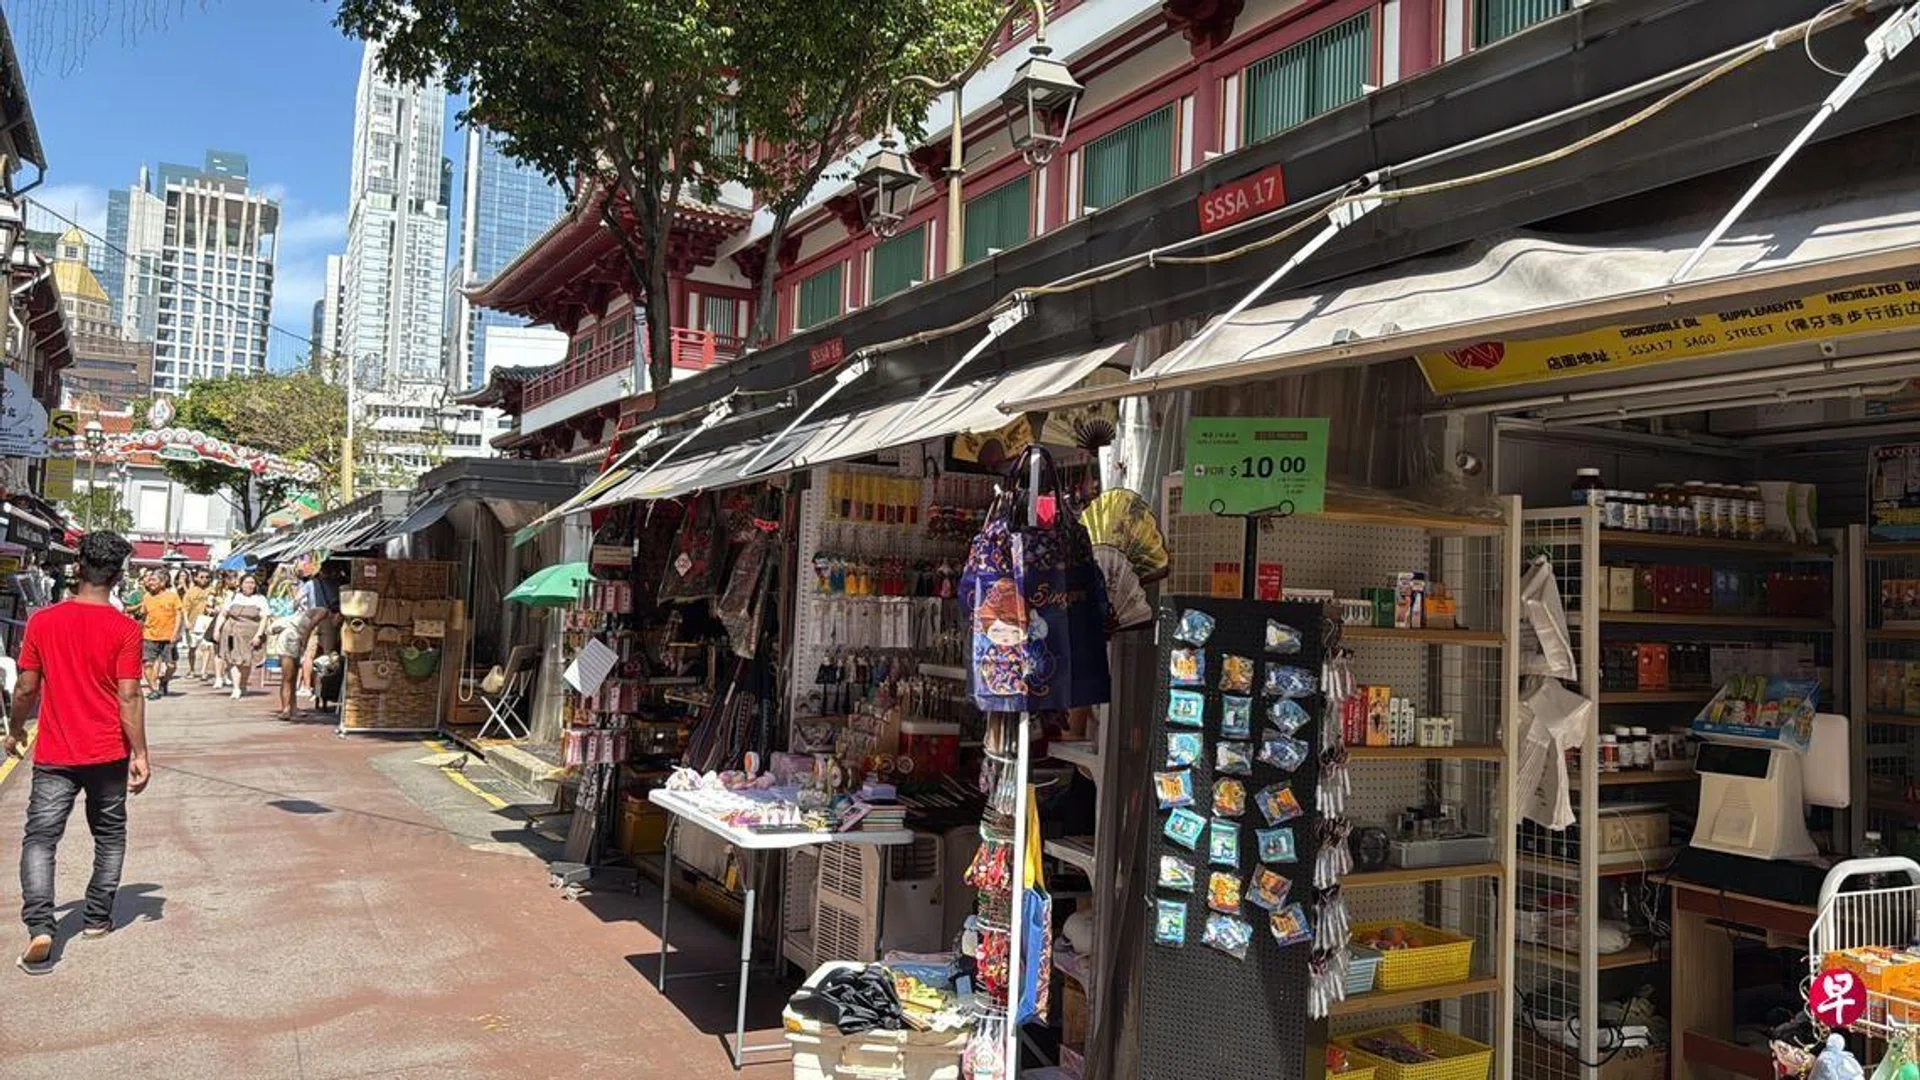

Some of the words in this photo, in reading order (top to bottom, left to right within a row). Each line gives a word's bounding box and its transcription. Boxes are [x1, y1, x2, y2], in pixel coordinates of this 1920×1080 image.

[1204, 188, 1249, 223] SSSA
[1253, 176, 1275, 205] 17
[1718, 299, 1804, 322] SUPPLEMENTS
[1826, 283, 1902, 304] MEDICATED
[1628, 340, 1673, 355] SSSA17
[1683, 334, 1716, 348] SAGO
[1725, 323, 1773, 341] STREET
